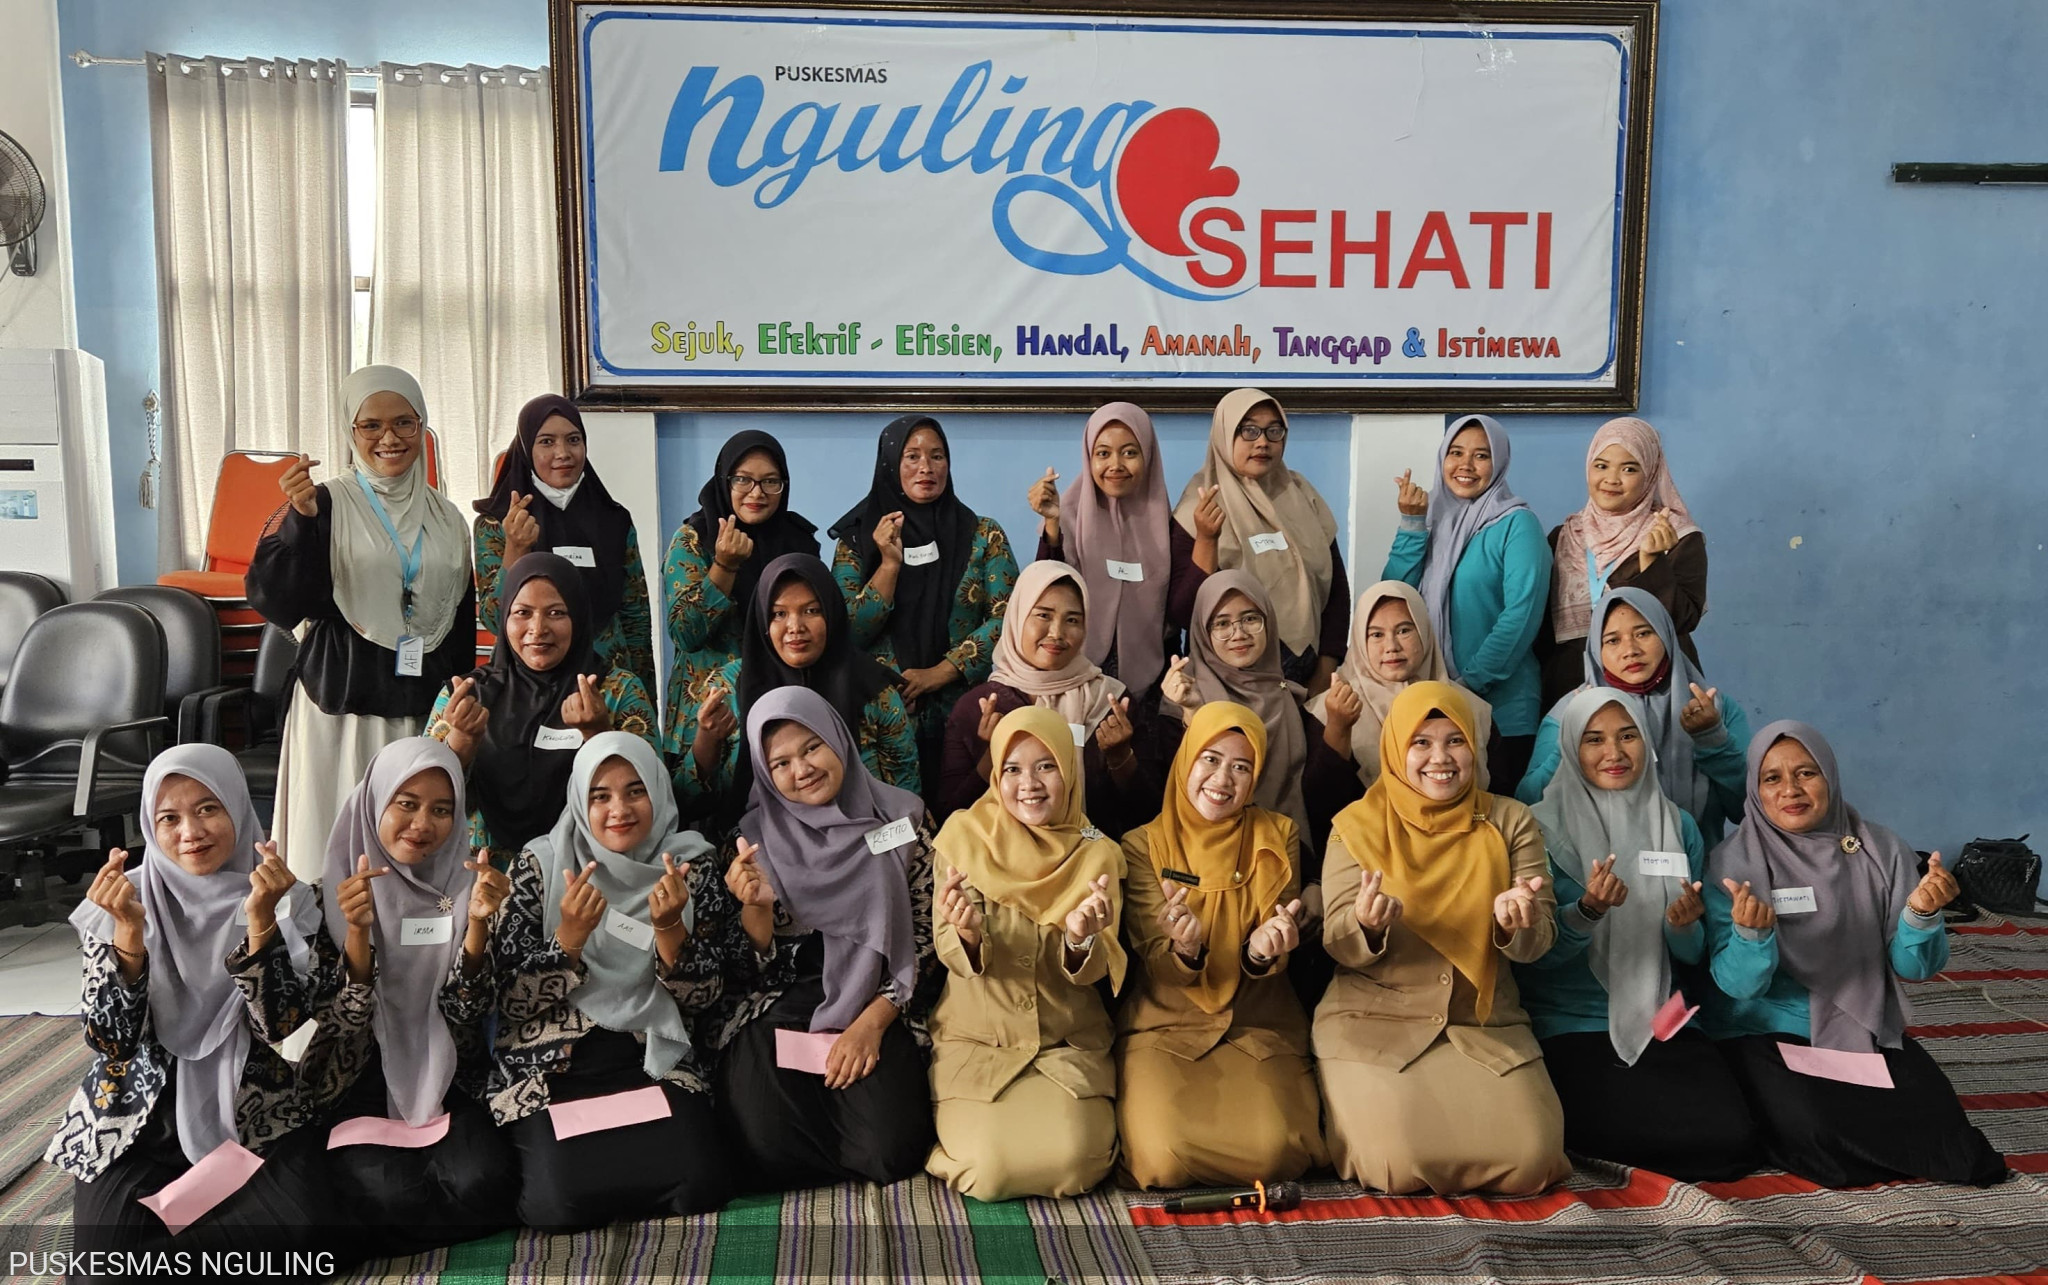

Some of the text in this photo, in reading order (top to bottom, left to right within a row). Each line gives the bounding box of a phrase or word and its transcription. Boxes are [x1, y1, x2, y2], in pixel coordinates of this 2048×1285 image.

[775, 65, 888, 84] PUSKESMAS
[1187, 207, 1552, 289] SEHATI
[1402, 327, 1427, 359] &
